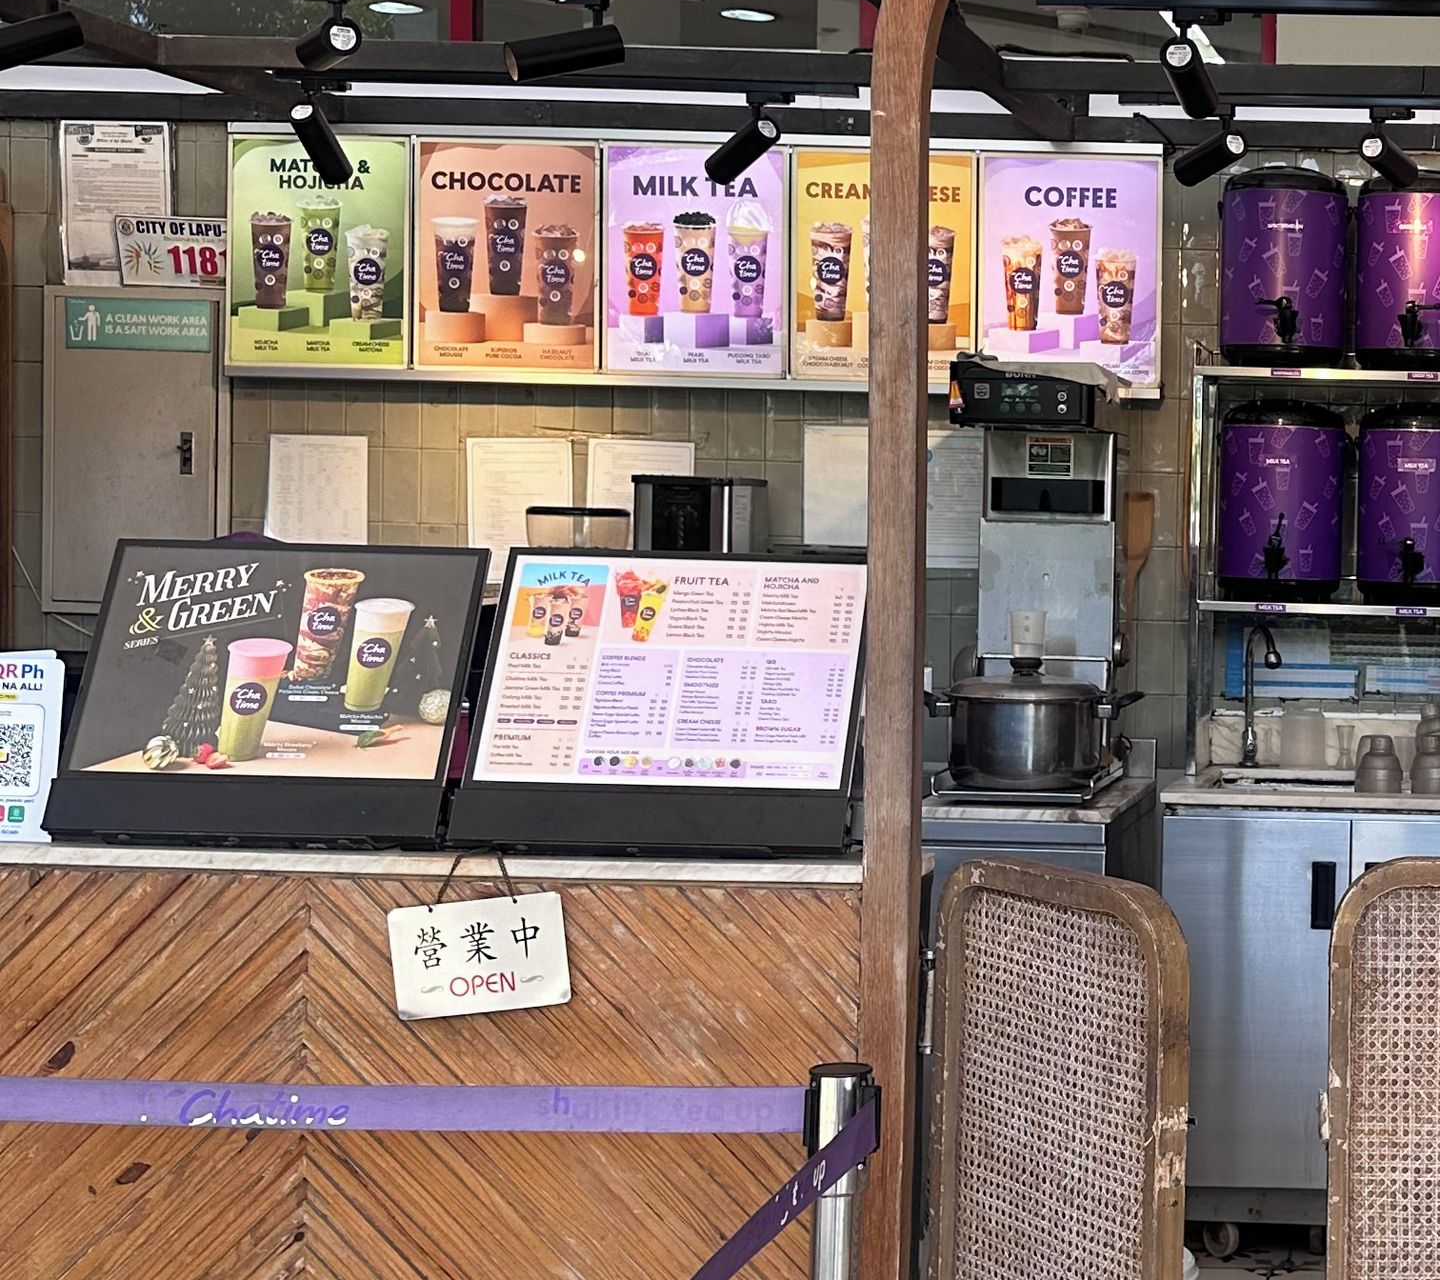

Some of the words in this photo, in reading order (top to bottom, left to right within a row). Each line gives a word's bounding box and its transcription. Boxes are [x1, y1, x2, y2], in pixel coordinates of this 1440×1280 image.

[357, 160, 370, 174] &
[431, 171, 581, 193] CHOCOLATE
[633, 175, 699, 197] MILK
[705, 176, 758, 198] TEA
[1024, 186, 1117, 208] COFFEE
[136, 221, 165, 234] CITY
[170, 222, 185, 235] OF
[106, 314, 113, 323] A
[115, 314, 147, 323] CLEAN
[148, 315, 179, 325] WORK
[181, 316, 207, 326] AREA
[105, 325, 113, 334] IS
[115, 325, 123, 334] A
[125, 325, 147, 335] SAFE
[149, 326, 179, 335] WORK
[181, 327, 208, 337] AREA
[136, 562, 259, 607] MERRY
[538, 571, 567, 587] MILK
[570, 571, 591, 587] TEA
[674, 576, 706, 585] FRUIT
[708, 577, 729, 586] TEA
[129, 607, 165, 635] &
[167, 590, 278, 631] GREEN
[312, 612, 336, 624] Cha
[123, 635, 159, 650] SERIES
[362, 642, 386, 655] Cha
[509, 652, 551, 660] CLASSICS
[21, 664, 44, 679] Ph
[2, 682, 17, 690] NA
[237, 687, 262, 701] Cha
[414, 917, 540, 970] 營業中
[450, 971, 516, 997] OPEN
[179, 1089, 350, 1126] Chatime
